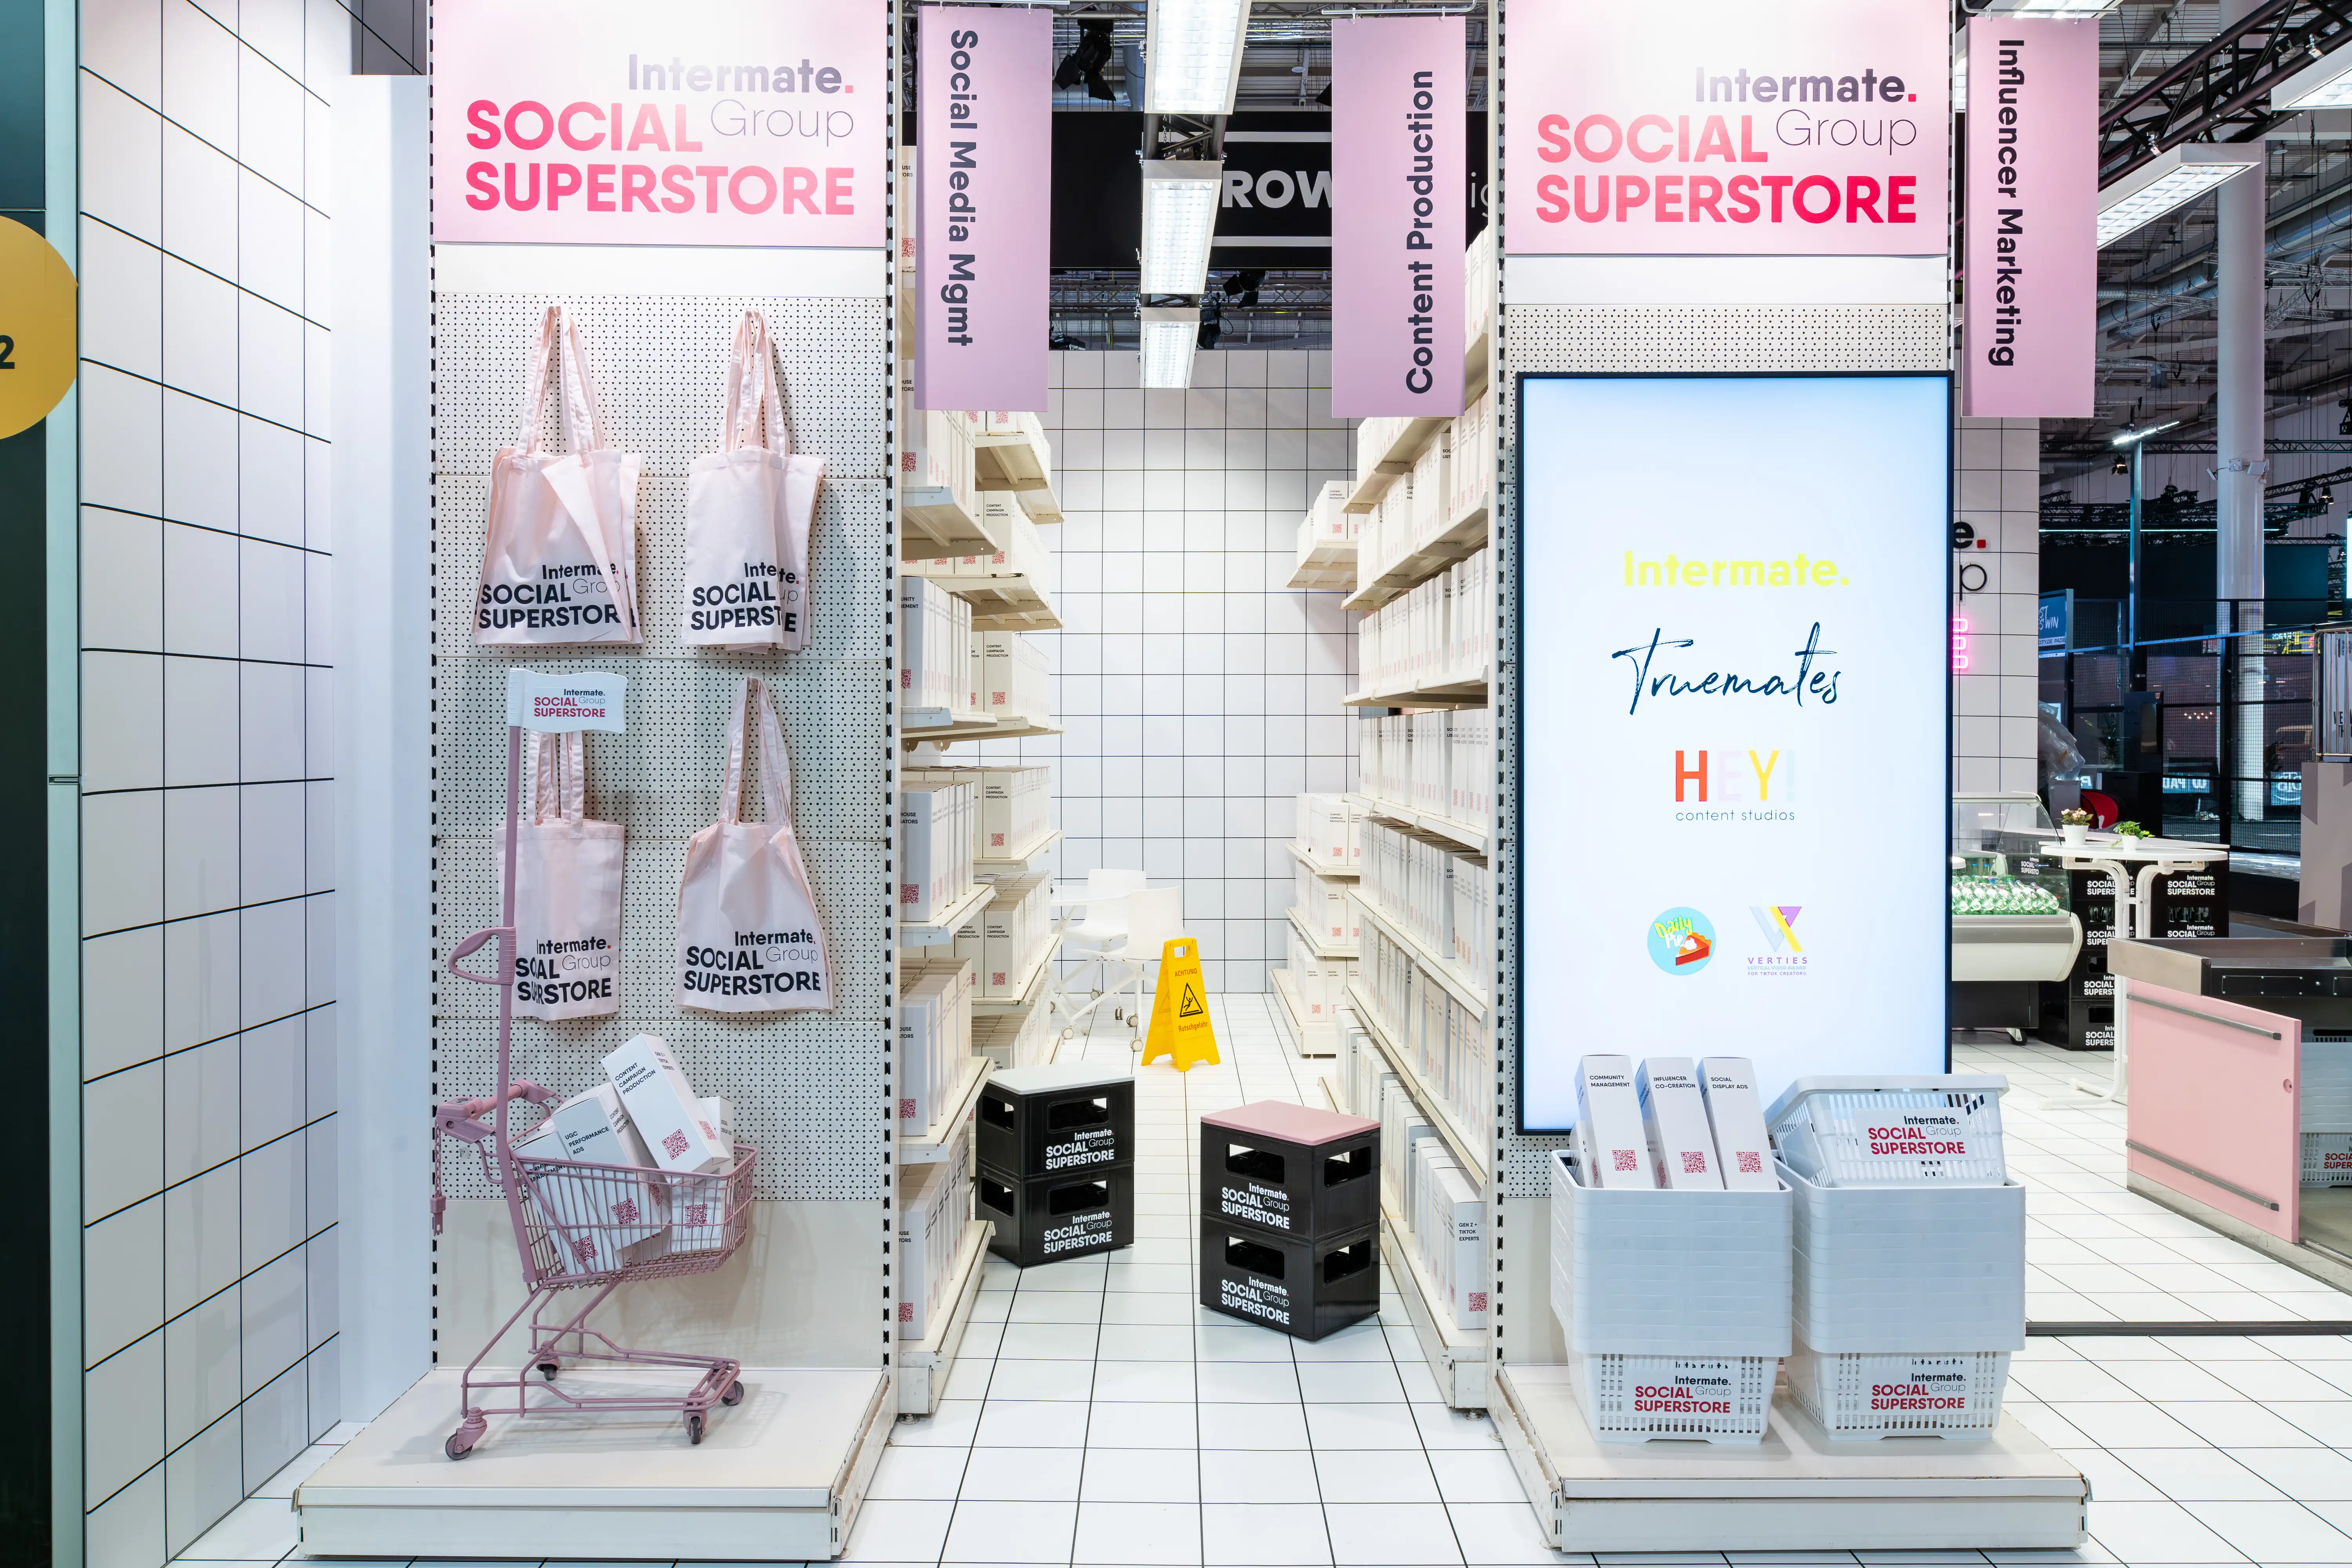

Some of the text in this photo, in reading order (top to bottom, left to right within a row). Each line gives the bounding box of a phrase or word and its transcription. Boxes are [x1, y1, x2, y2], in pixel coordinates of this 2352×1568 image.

[628, 54, 853, 94] Intermate.
[1696, 67, 1916, 102] Intermate.
[466, 99, 853, 152] SOCIAL Group
[1537, 109, 1916, 163] SOCIAL Group
[465, 161, 854, 215] SUPERSTORE
[941, 30, 978, 346] Social Media Mgmt
[1536, 174, 1916, 224] SUPERSTORE
[1988, 40, 2025, 366] Influencer Marketing
[1406, 71, 1433, 394] Content Production
[1624, 551, 1849, 587] Intermate.
[481, 583, 571, 604] SOCIAL
[692, 581, 776, 606] SOCIAL
[479, 604, 621, 629] SUPERSTOR
[1612, 621, 1841, 715] Truemates
[534, 696, 606, 706] SOCIAL Group
[534, 708, 606, 717] SUPERSTORE
[1676, 809, 1795, 820] content studios
[735, 928, 816, 946] Intermate.
[1653, 915, 1693, 938] Daily
[537, 936, 611, 954] Intermate.
[1664, 933, 1684, 949] Pie
[562, 955, 610, 971] Group
[686, 946, 818, 971] SOCIAL Group
[684, 969, 821, 995] SUPERSTORE
[1174, 968, 1198, 977] ACHTUNG
[1178, 1021, 1208, 1032] Rutschgefahr
[615, 1063, 638, 1081] CONTENT
[619, 1067, 646, 1088] CAMPAIGN
[622, 1069, 656, 1095] PRODUCTION
[1904, 1115, 1959, 1125] Intermate.
[565, 1131, 578, 1140] UGC
[568, 1126, 610, 1147] PERFORMANCE
[1074, 1129, 1114, 1141] Intermate.
[1868, 1125, 1961, 1140] SOCIAL Group
[573, 1147, 584, 1155] ADS
[1046, 1138, 1114, 1157] SOCIAL Group
[1870, 1142, 1966, 1155] SUPERSTORE
[1046, 1149, 1114, 1170] SUPERSTORE
[1222, 1187, 1289, 1212] SOCIAL Group
[1249, 1182, 1289, 1201] Intermate.
[1073, 1211, 1112, 1224] Intermate.
[1222, 1201, 1289, 1229] SUPERSTORE
[1044, 1220, 1112, 1241] SOCIAL Group
[1044, 1231, 1112, 1254] SUPERSTORE
[1221, 1279, 1289, 1307] SOCIAL Group
[1249, 1276, 1289, 1297] Intermate.
[1221, 1293, 1289, 1325] SUPERSTORE
[1675, 1376, 1731, 1385] Intermate.
[1911, 1372, 1966, 1382] Intermate.
[1635, 1385, 1731, 1399] SOCIAL Group
[1872, 1382, 1966, 1396] SOCIAL Group
[1634, 1400, 1731, 1413] SUPERSTORE
[1871, 1397, 1965, 1410] SUPERSTORE
